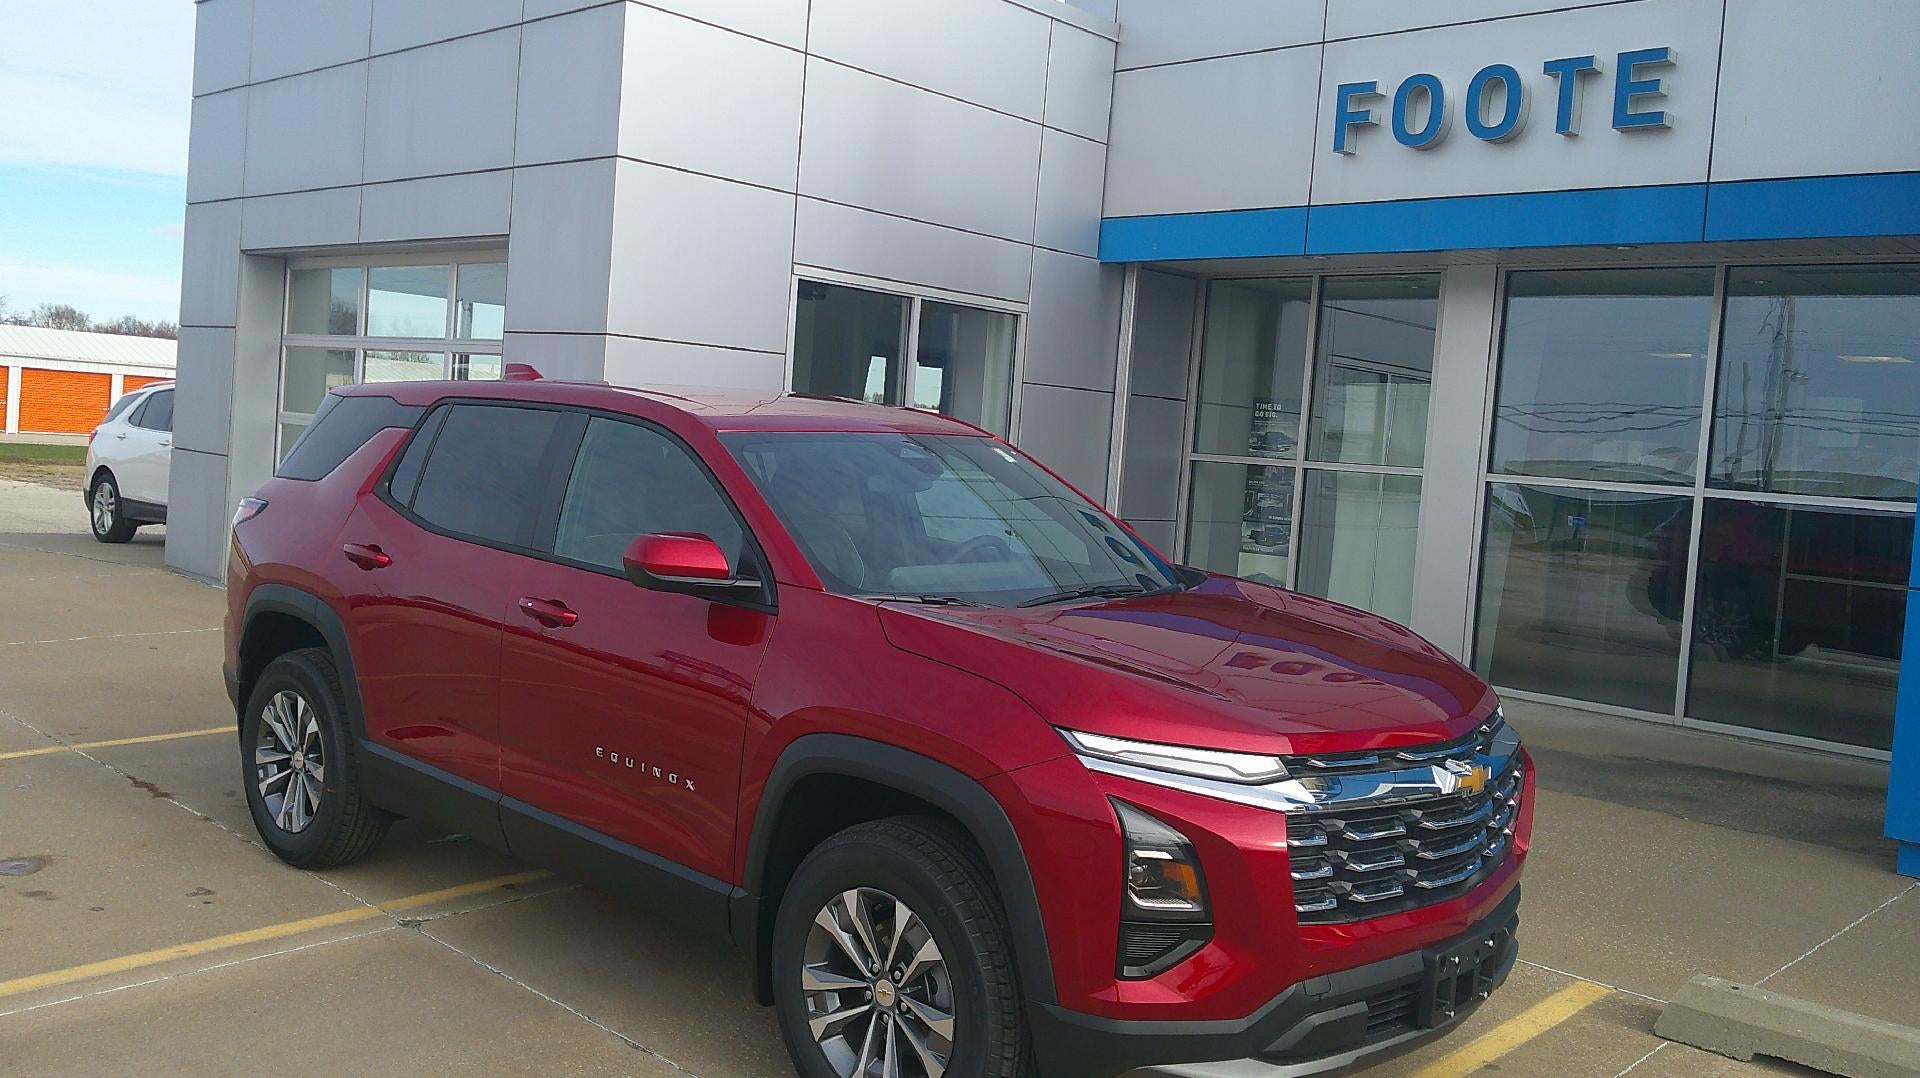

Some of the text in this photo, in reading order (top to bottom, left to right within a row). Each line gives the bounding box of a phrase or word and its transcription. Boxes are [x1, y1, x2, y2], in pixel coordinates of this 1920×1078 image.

[1333, 46, 1677, 156] FOOTE
[1273, 403, 1282, 411] TO
[595, 746, 696, 791] EQUINOX
